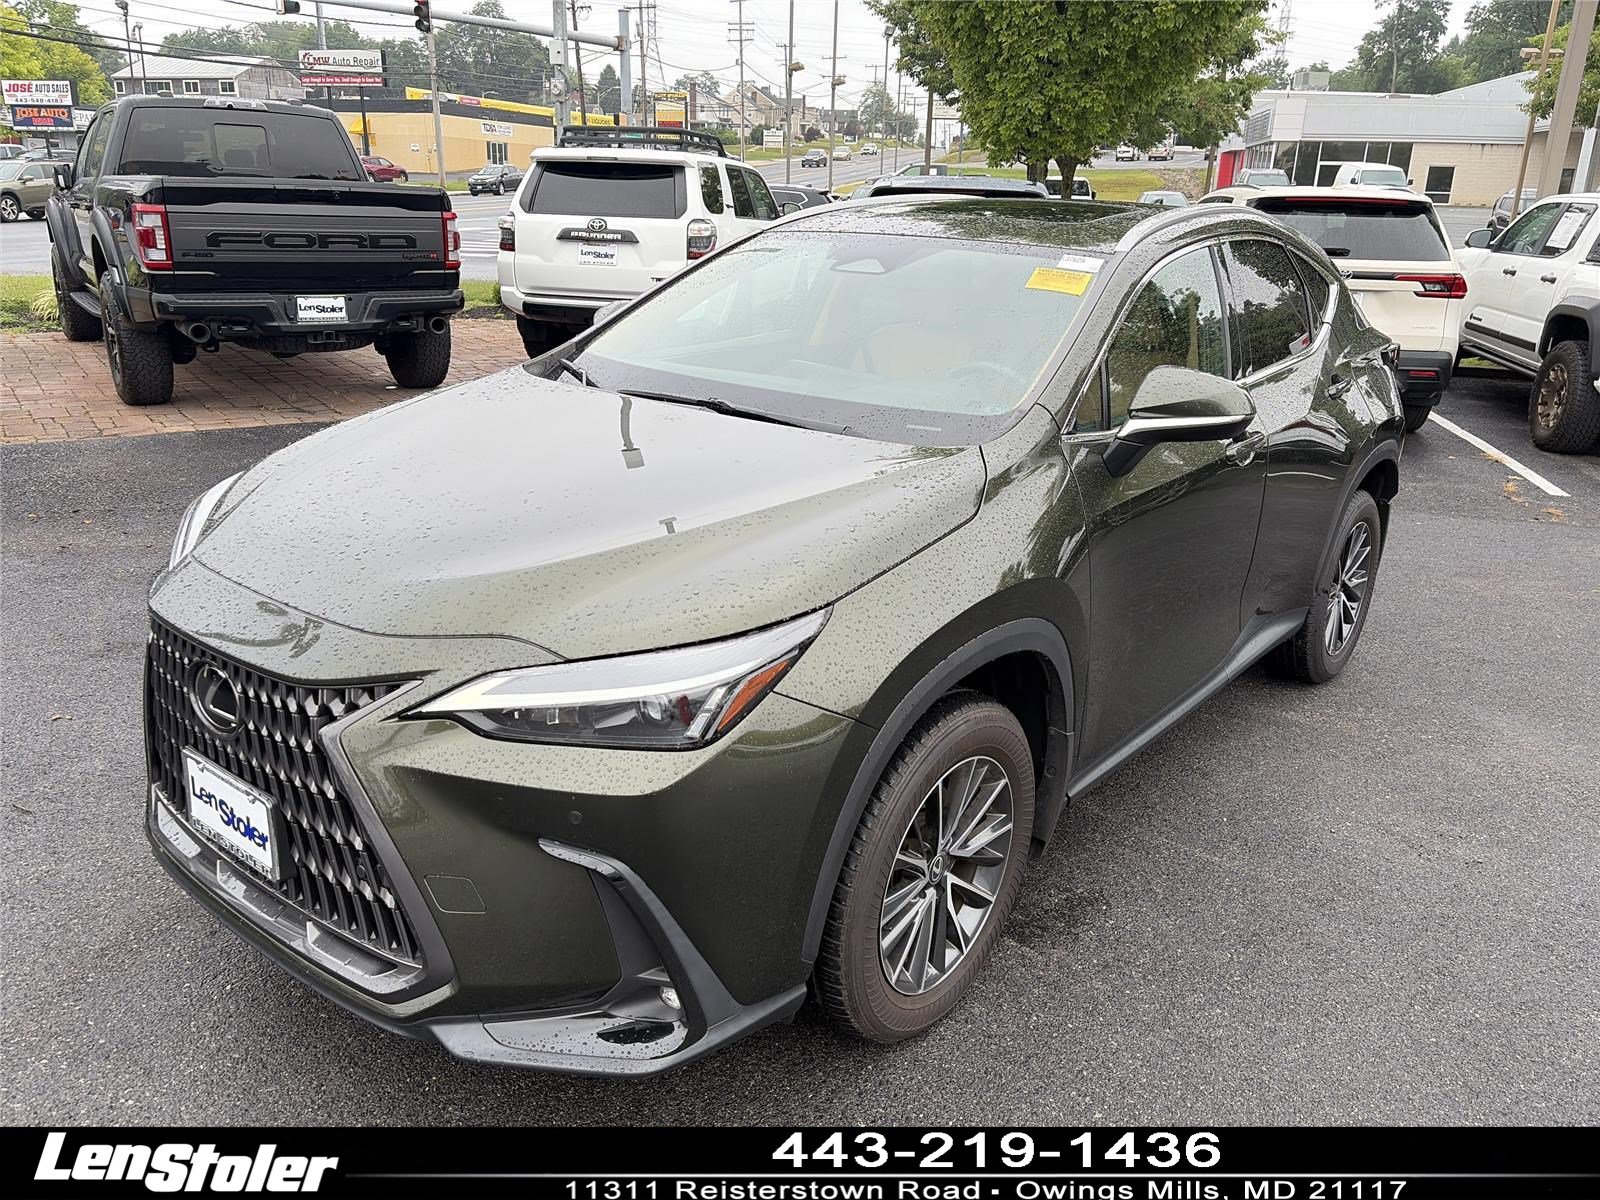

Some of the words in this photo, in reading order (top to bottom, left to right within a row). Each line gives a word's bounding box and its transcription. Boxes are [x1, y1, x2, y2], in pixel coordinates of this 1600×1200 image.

[332, 57, 350, 66] Auto
[353, 57, 380, 67] Repair
[5, 83, 33, 93] JOSÉ
[35, 83, 51, 93] AUTO
[52, 84, 69, 93] SALES
[16, 107, 39, 117] JOSE
[40, 107, 68, 117] AUTO
[206, 231, 417, 249] FORD
